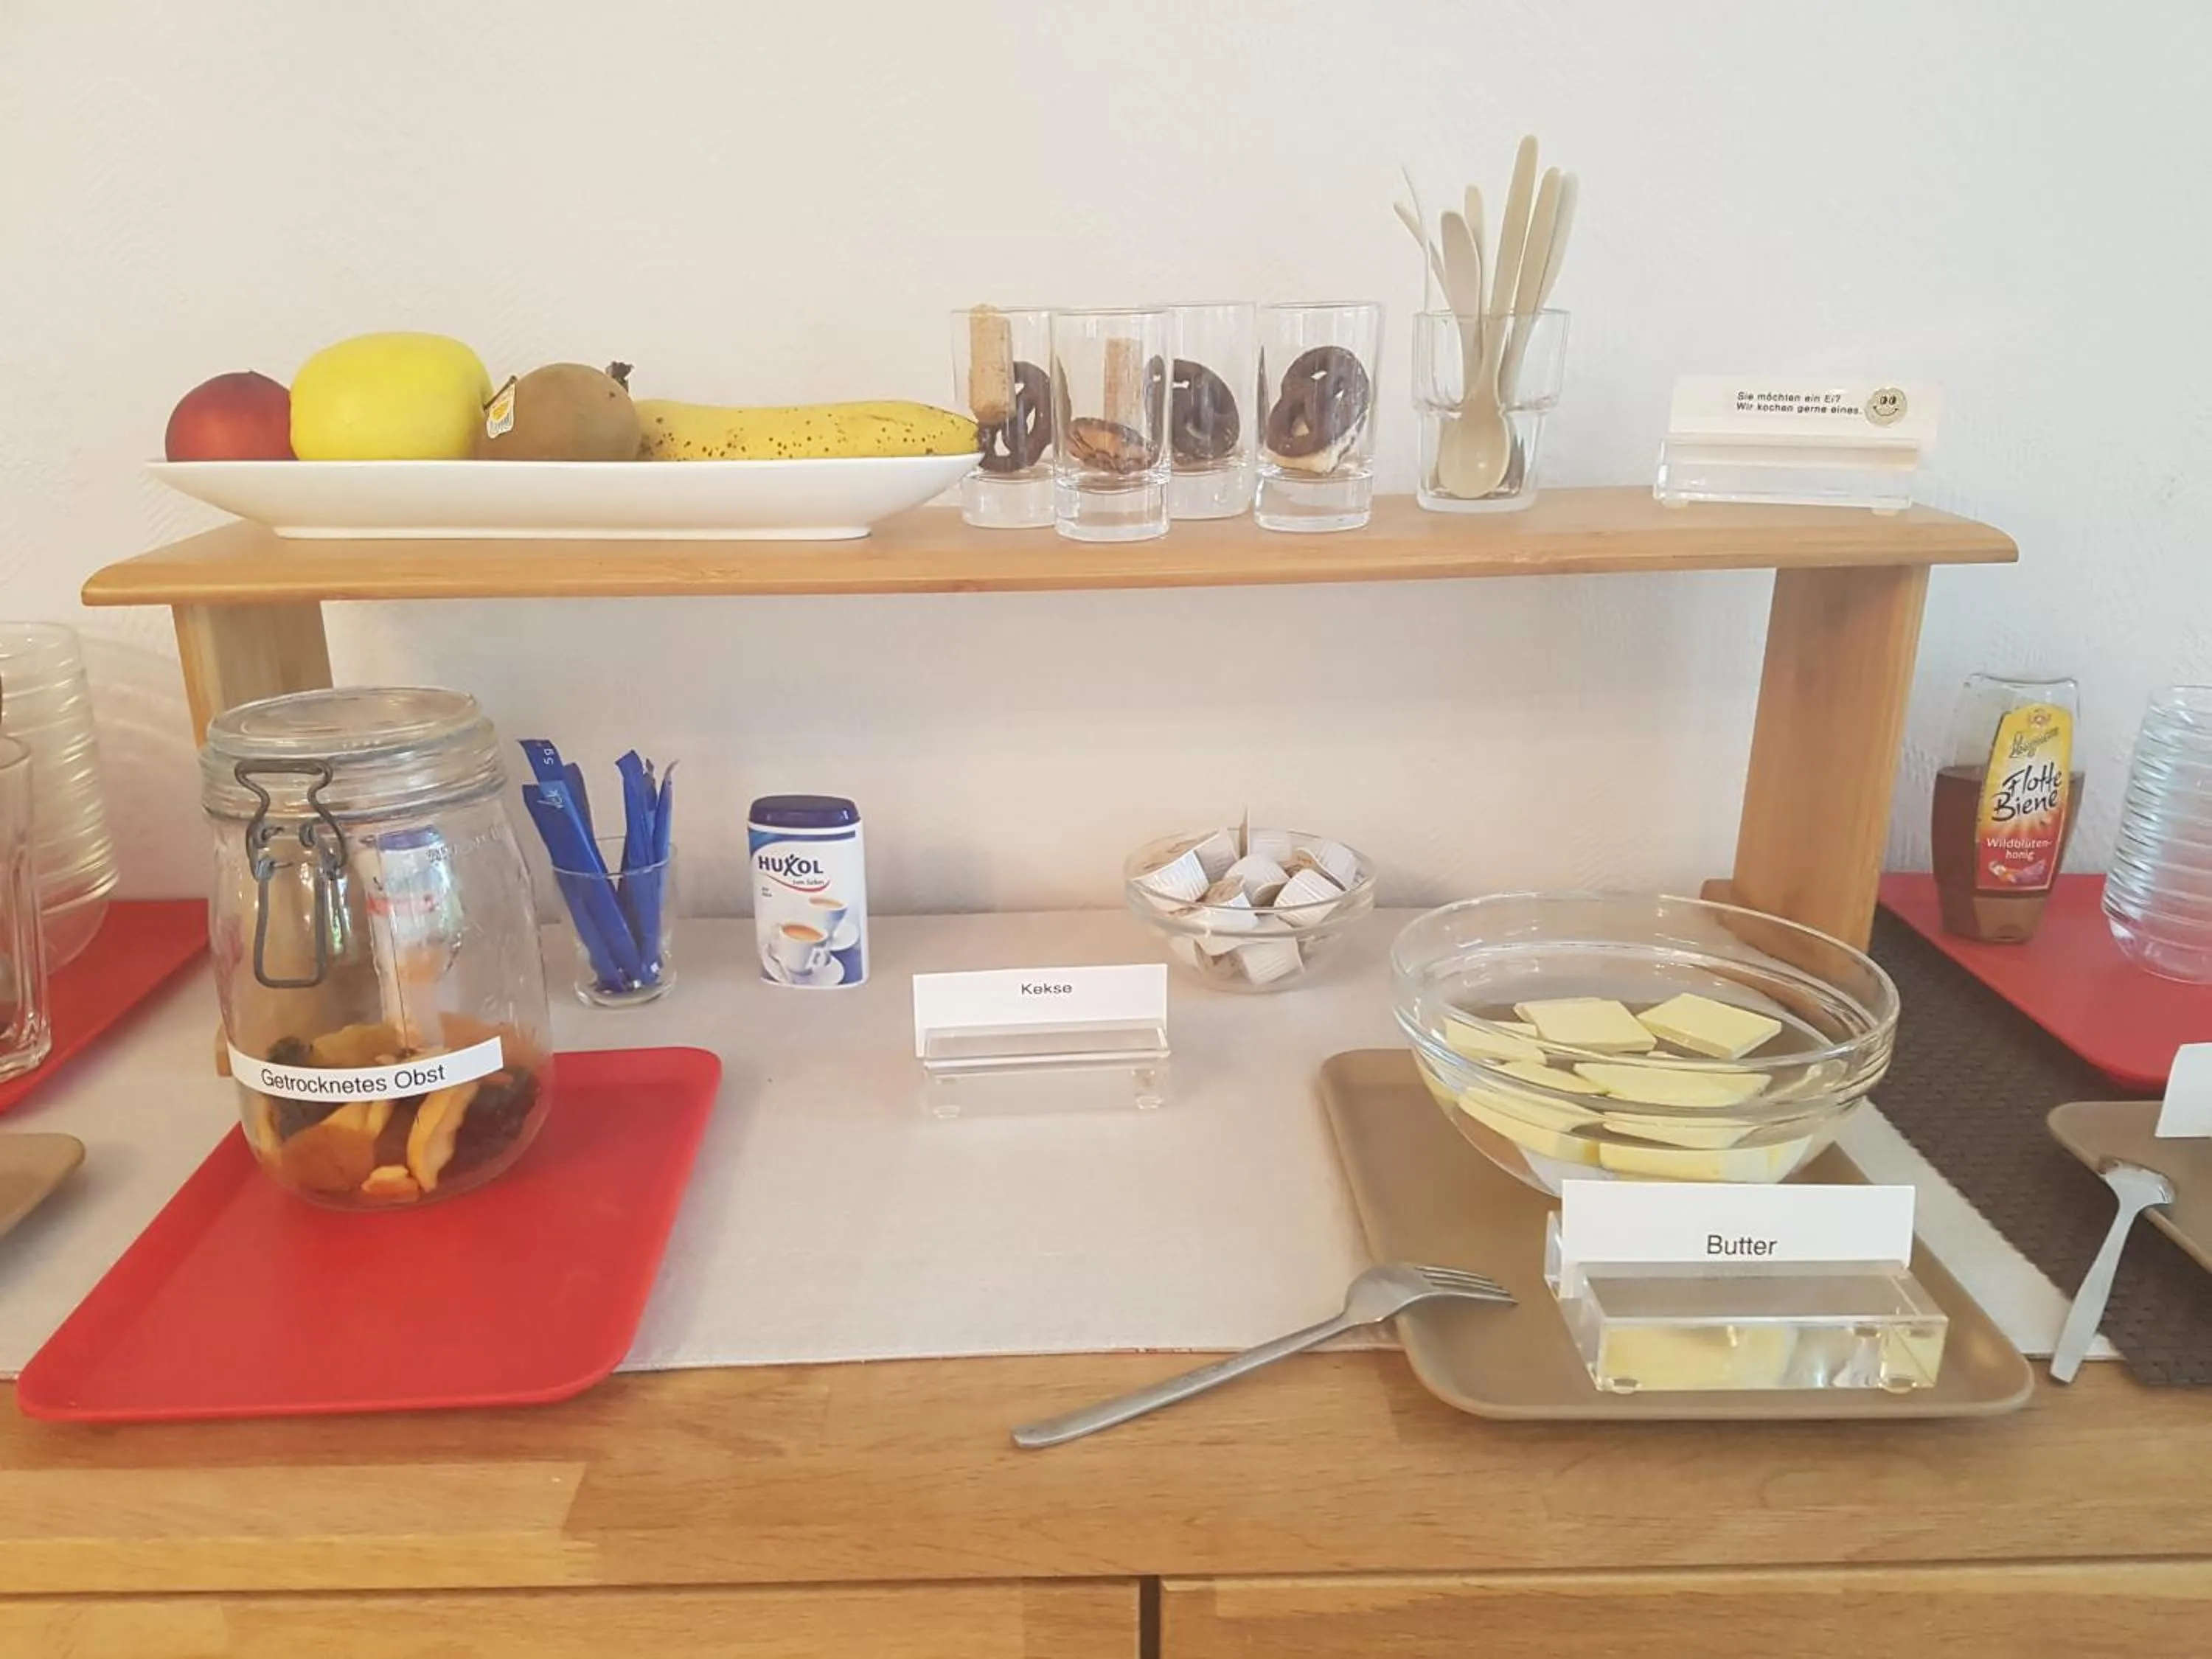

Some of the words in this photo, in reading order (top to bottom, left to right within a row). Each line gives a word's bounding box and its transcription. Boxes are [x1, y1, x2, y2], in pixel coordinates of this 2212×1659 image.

[1737, 392, 1754, 401] Sie
[1757, 392, 1801, 403] möchten
[1804, 394, 1820, 403] ein
[1824, 394, 1841, 403] Ei?
[1736, 403, 1753, 411] Wir
[1757, 403, 1793, 412] kochen
[1797, 406, 1827, 414] gerne
[1831, 406, 1863, 415] eines.
[2002, 762, 2062, 795] Flotte
[1991, 790, 2059, 822] Biene
[758, 854, 824, 877] HUXOL
[1021, 983, 1072, 995] Kekse
[261, 1068, 387, 1094] Getrocknetes
[394, 1064, 445, 1090] Obst
[1707, 1234, 1778, 1255] Butter
